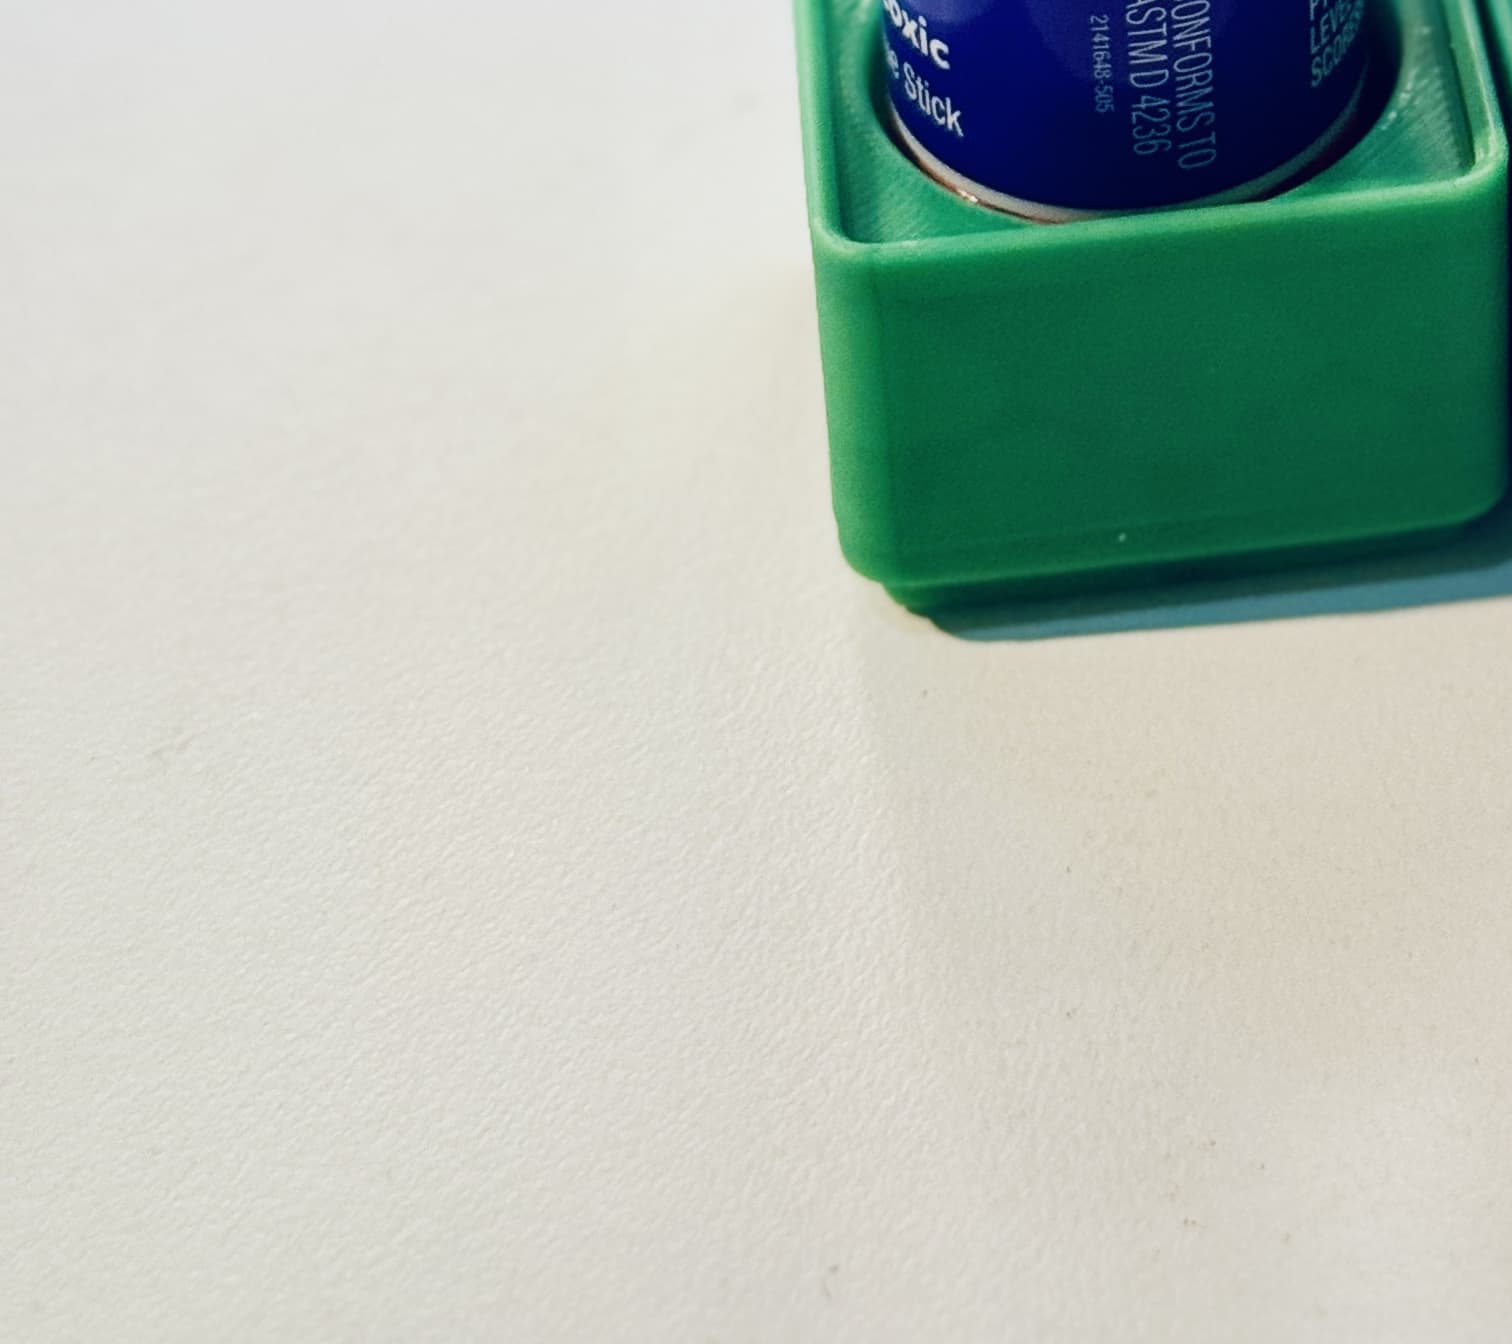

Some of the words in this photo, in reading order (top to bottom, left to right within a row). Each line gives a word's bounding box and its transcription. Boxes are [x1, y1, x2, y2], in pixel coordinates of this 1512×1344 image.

[903, 62, 964, 137] Stick
[1131, 94, 1173, 155] 4236
[1176, 130, 1217, 170] TO
